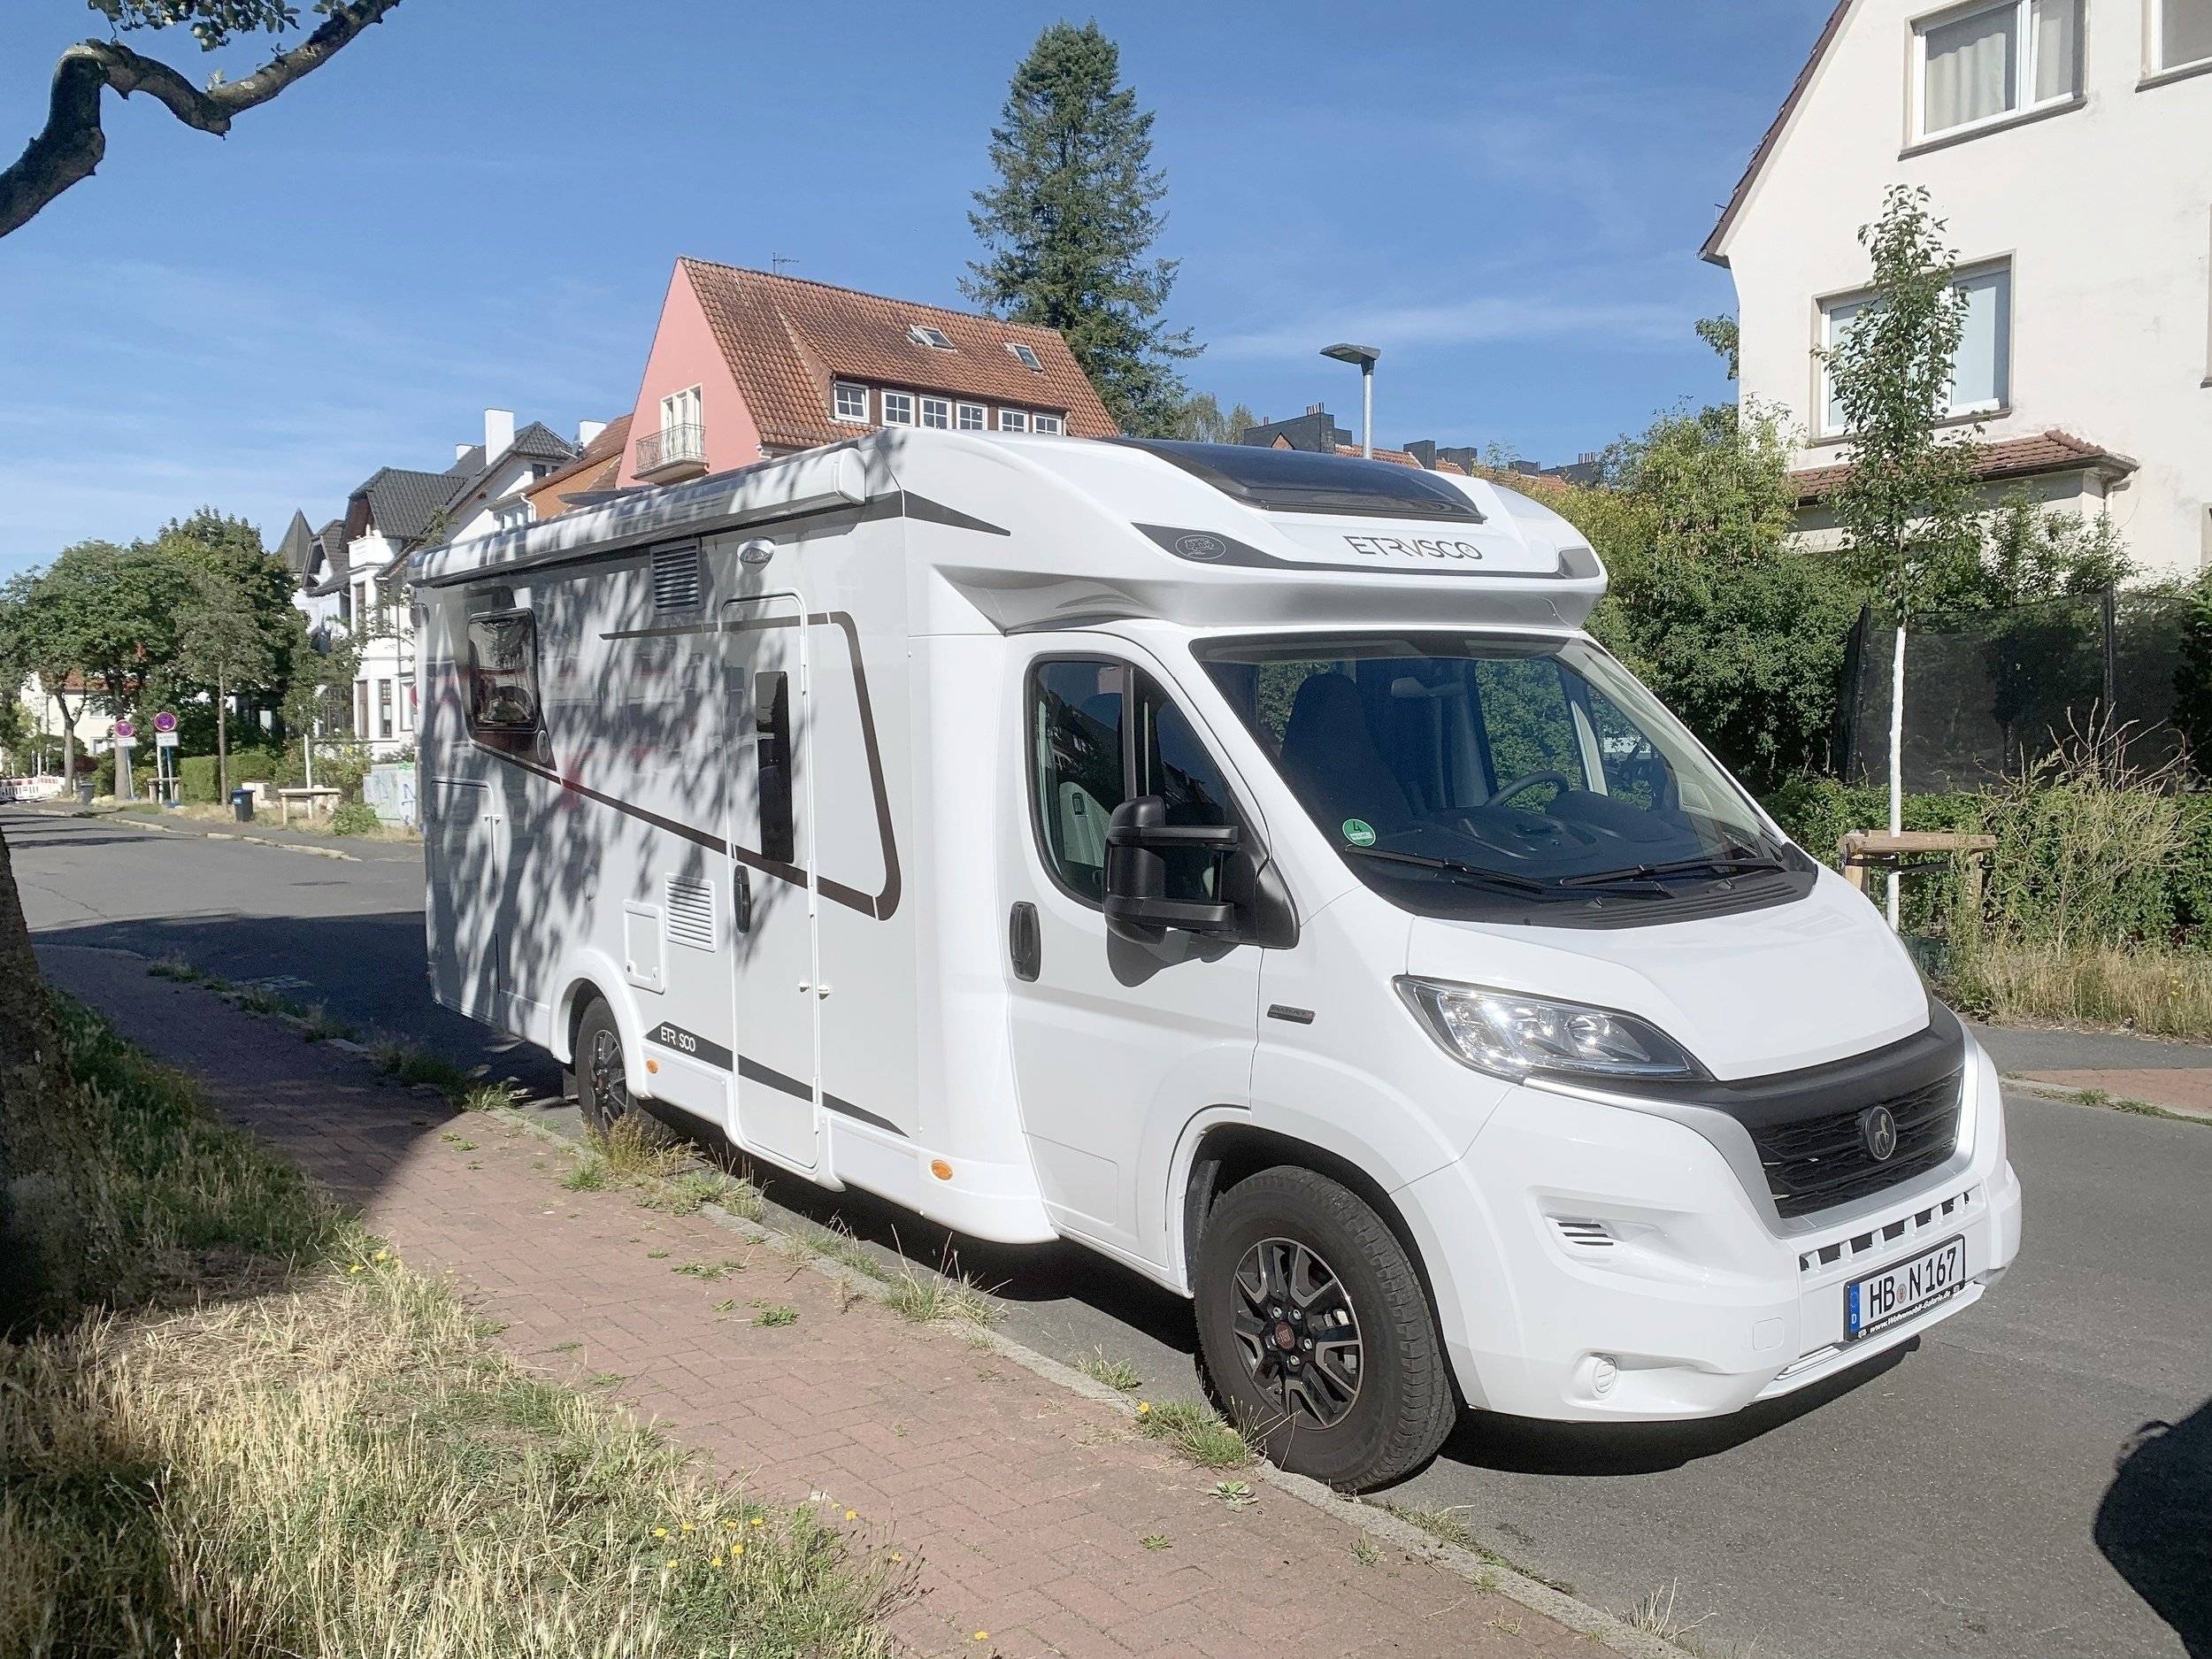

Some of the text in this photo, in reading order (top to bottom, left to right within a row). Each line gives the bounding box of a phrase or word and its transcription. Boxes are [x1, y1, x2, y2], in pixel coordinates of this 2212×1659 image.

[1353, 820, 1363, 832] 4
[1851, 1247, 1956, 1325] D HB N 167
